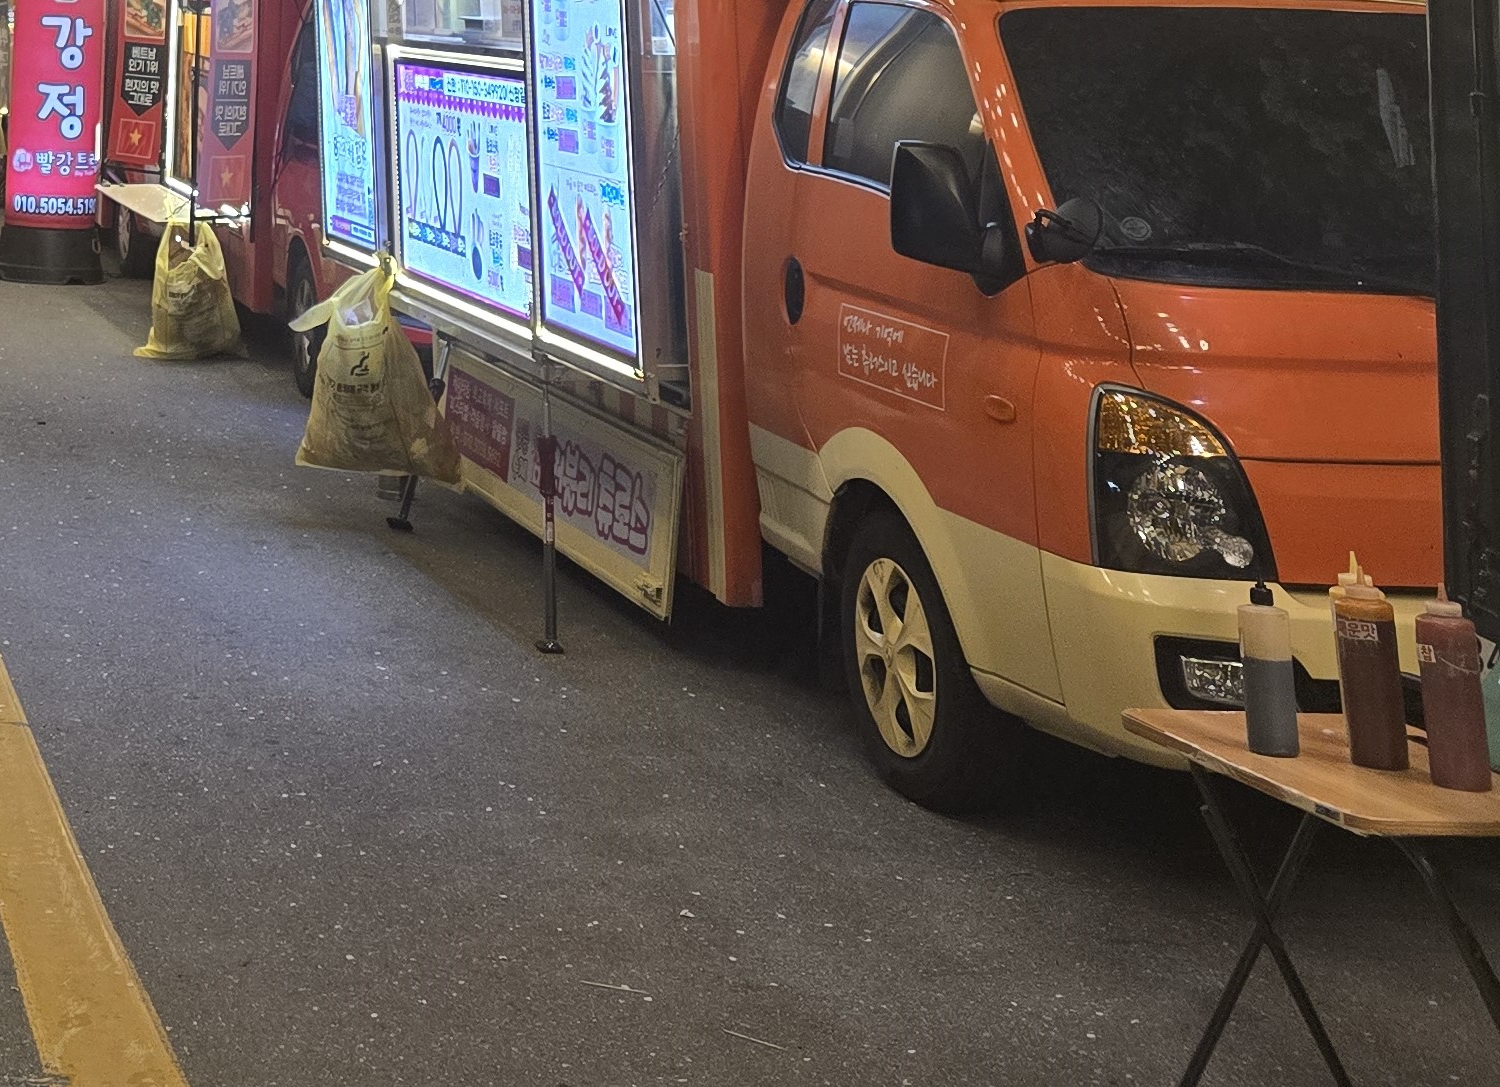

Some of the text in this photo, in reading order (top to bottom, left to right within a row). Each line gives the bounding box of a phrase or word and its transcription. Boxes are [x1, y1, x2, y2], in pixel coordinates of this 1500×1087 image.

[132, 46, 156, 60] 베트남
[128, 59, 159, 73] 인기 1위
[124, 78, 160, 94] 현지의 맛
[127, 92, 153, 106] 그대로
[843, 315, 904, 347] 언제나 기억에
